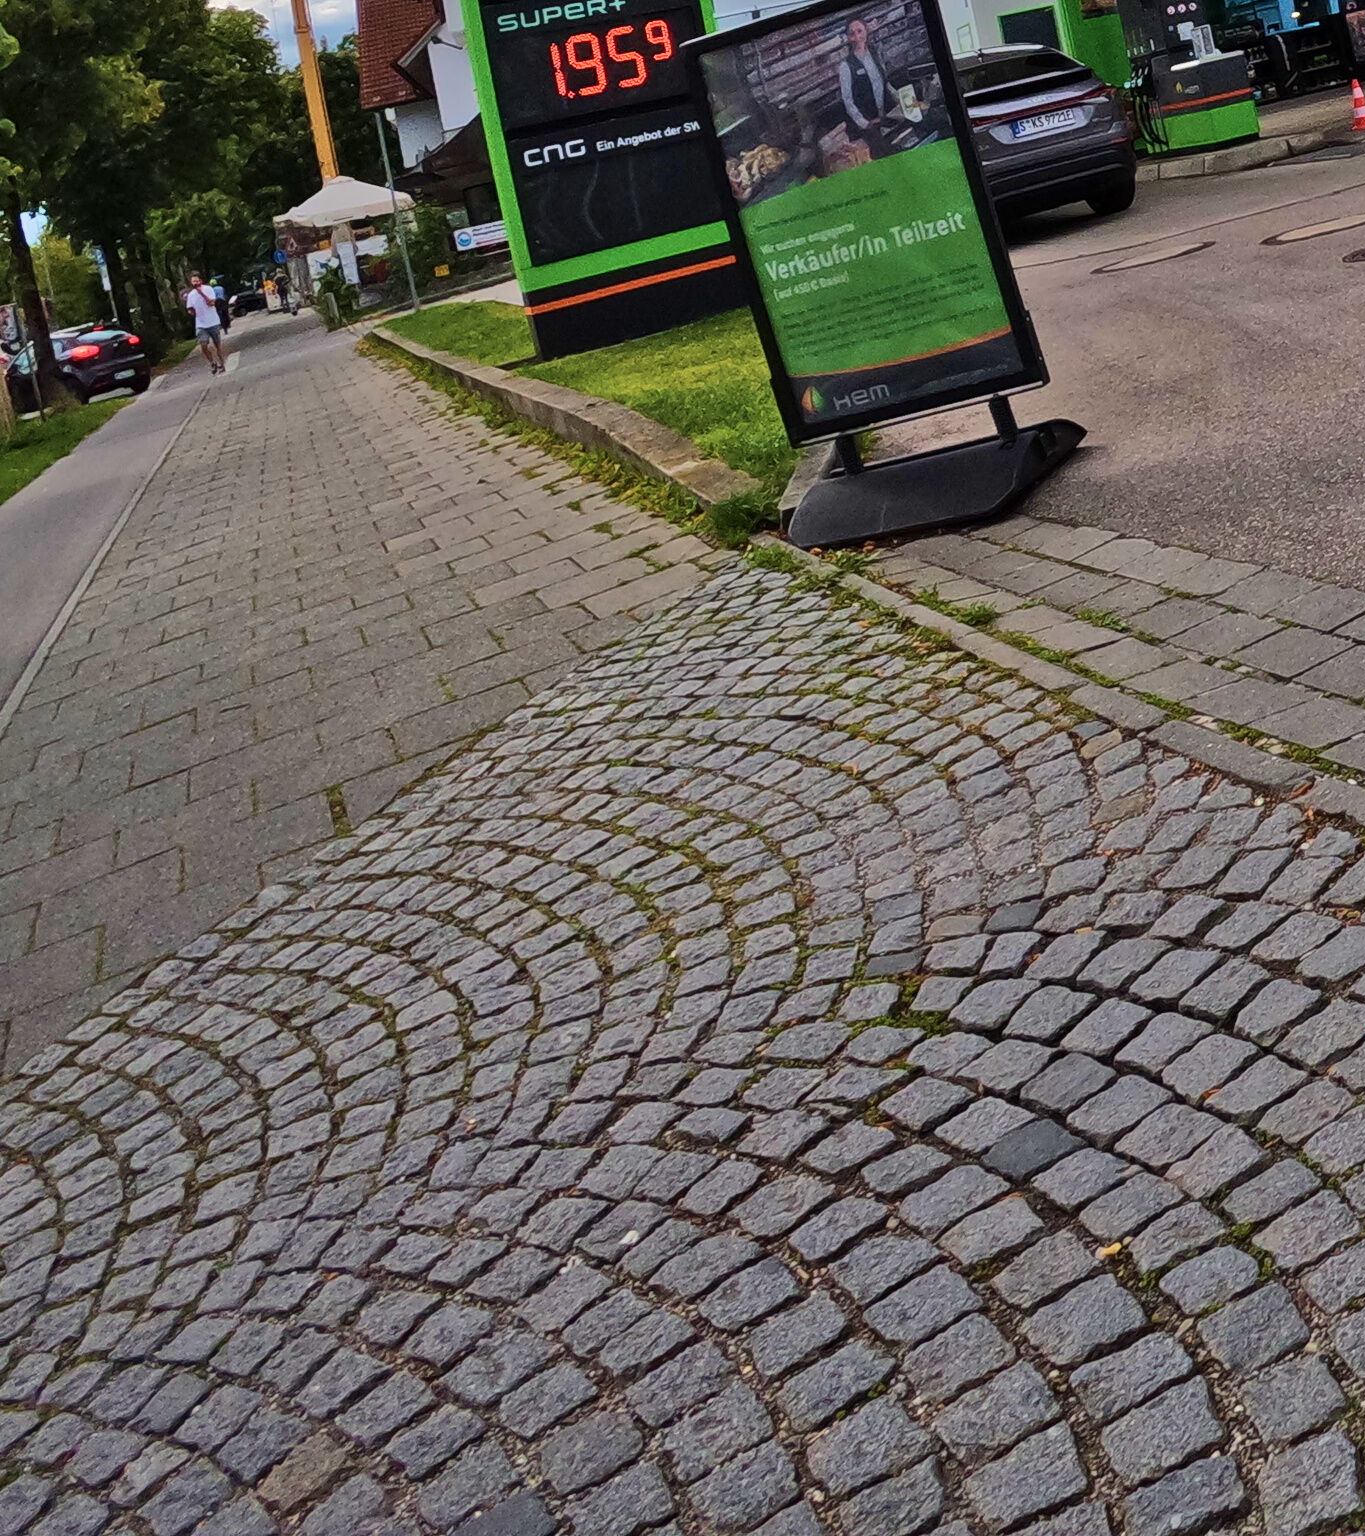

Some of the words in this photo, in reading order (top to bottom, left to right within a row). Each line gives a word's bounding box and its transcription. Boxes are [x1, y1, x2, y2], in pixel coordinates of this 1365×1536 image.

[595, 139, 615, 153] Ein
[617, 130, 663, 147] Angebot
[663, 126, 682, 138] der
[765, 234, 888, 282] Verkäufer/in
[888, 211, 967, 248] Teilzeit
